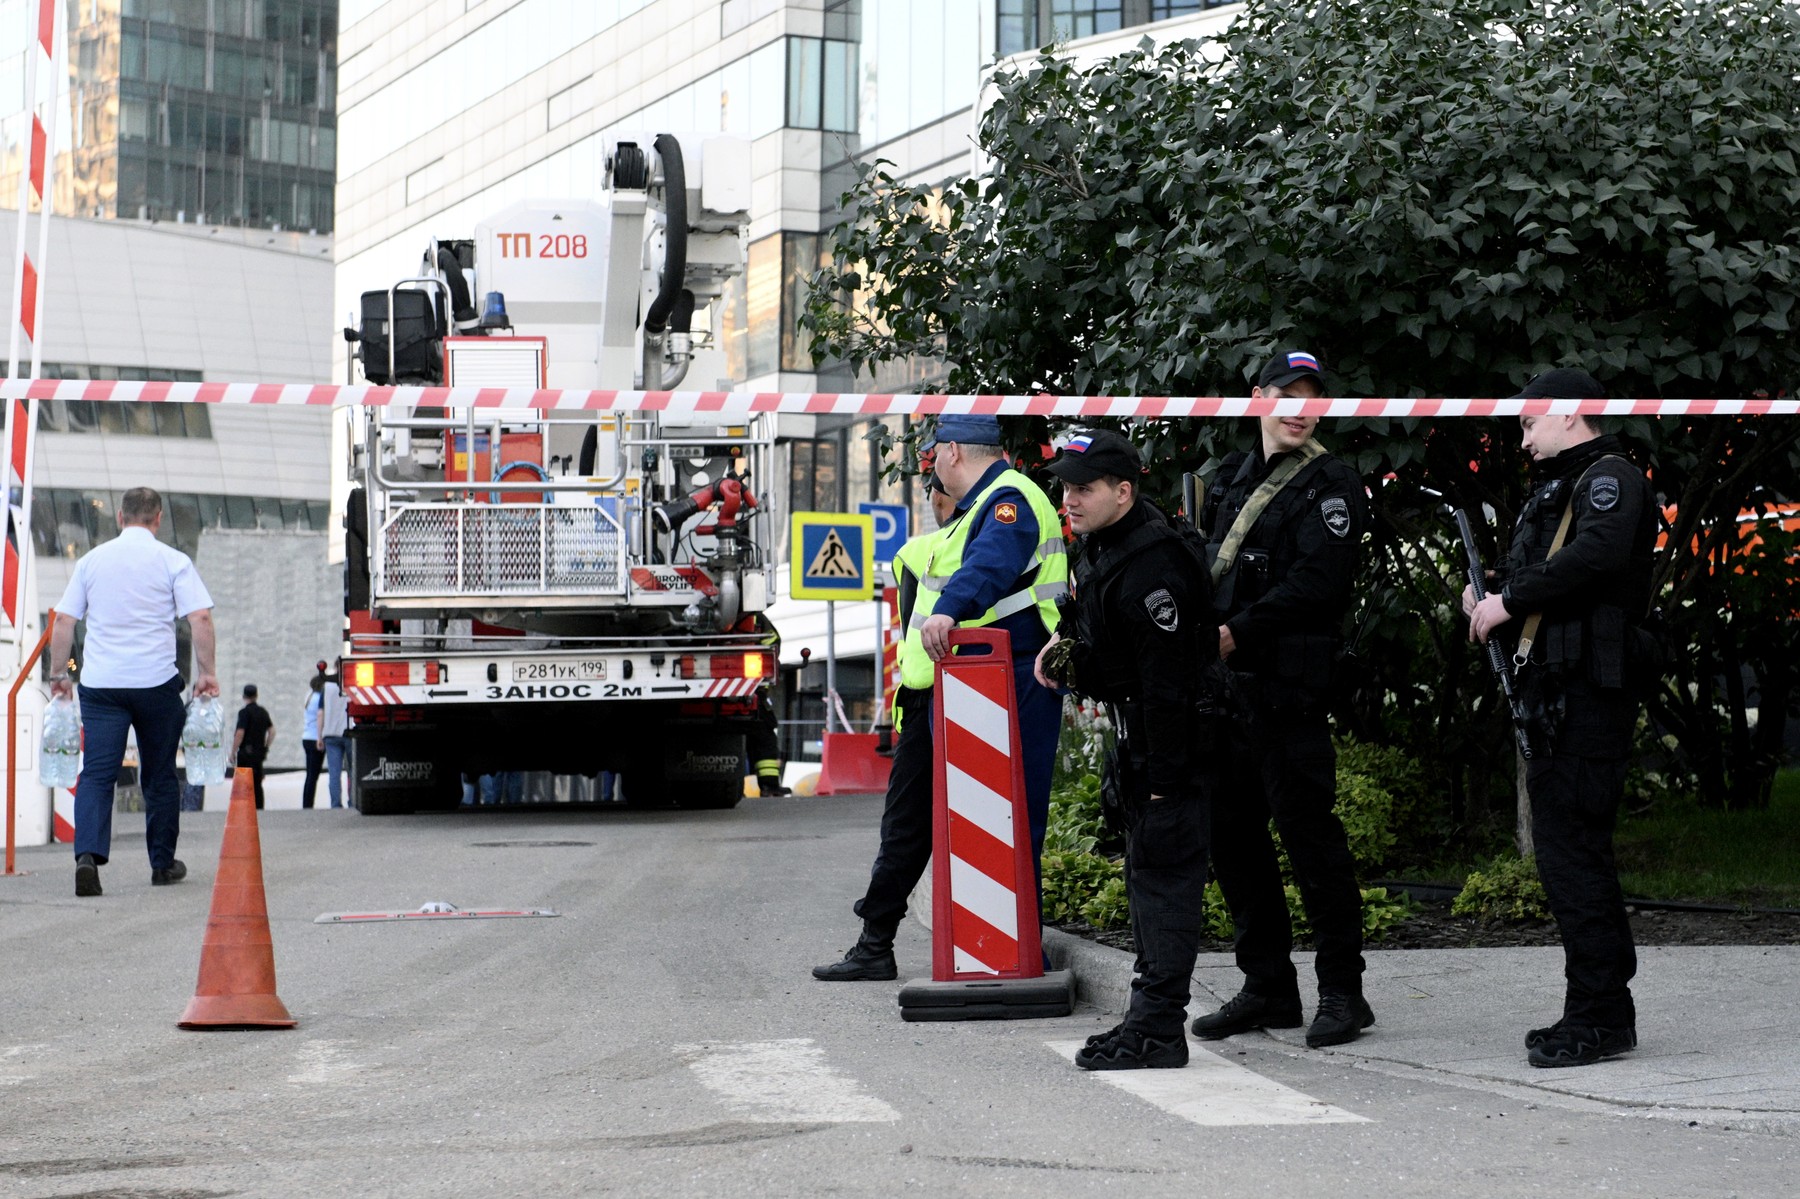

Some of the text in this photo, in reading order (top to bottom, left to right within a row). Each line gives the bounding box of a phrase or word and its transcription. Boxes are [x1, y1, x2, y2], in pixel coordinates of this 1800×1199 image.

[497, 233, 587, 258] ТП 208
[871, 510, 897, 555] P
[486, 685, 592, 698] ЗАНОС
[385, 762, 433, 770] BRONTO
[385, 771, 431, 779] SKYLIFT
